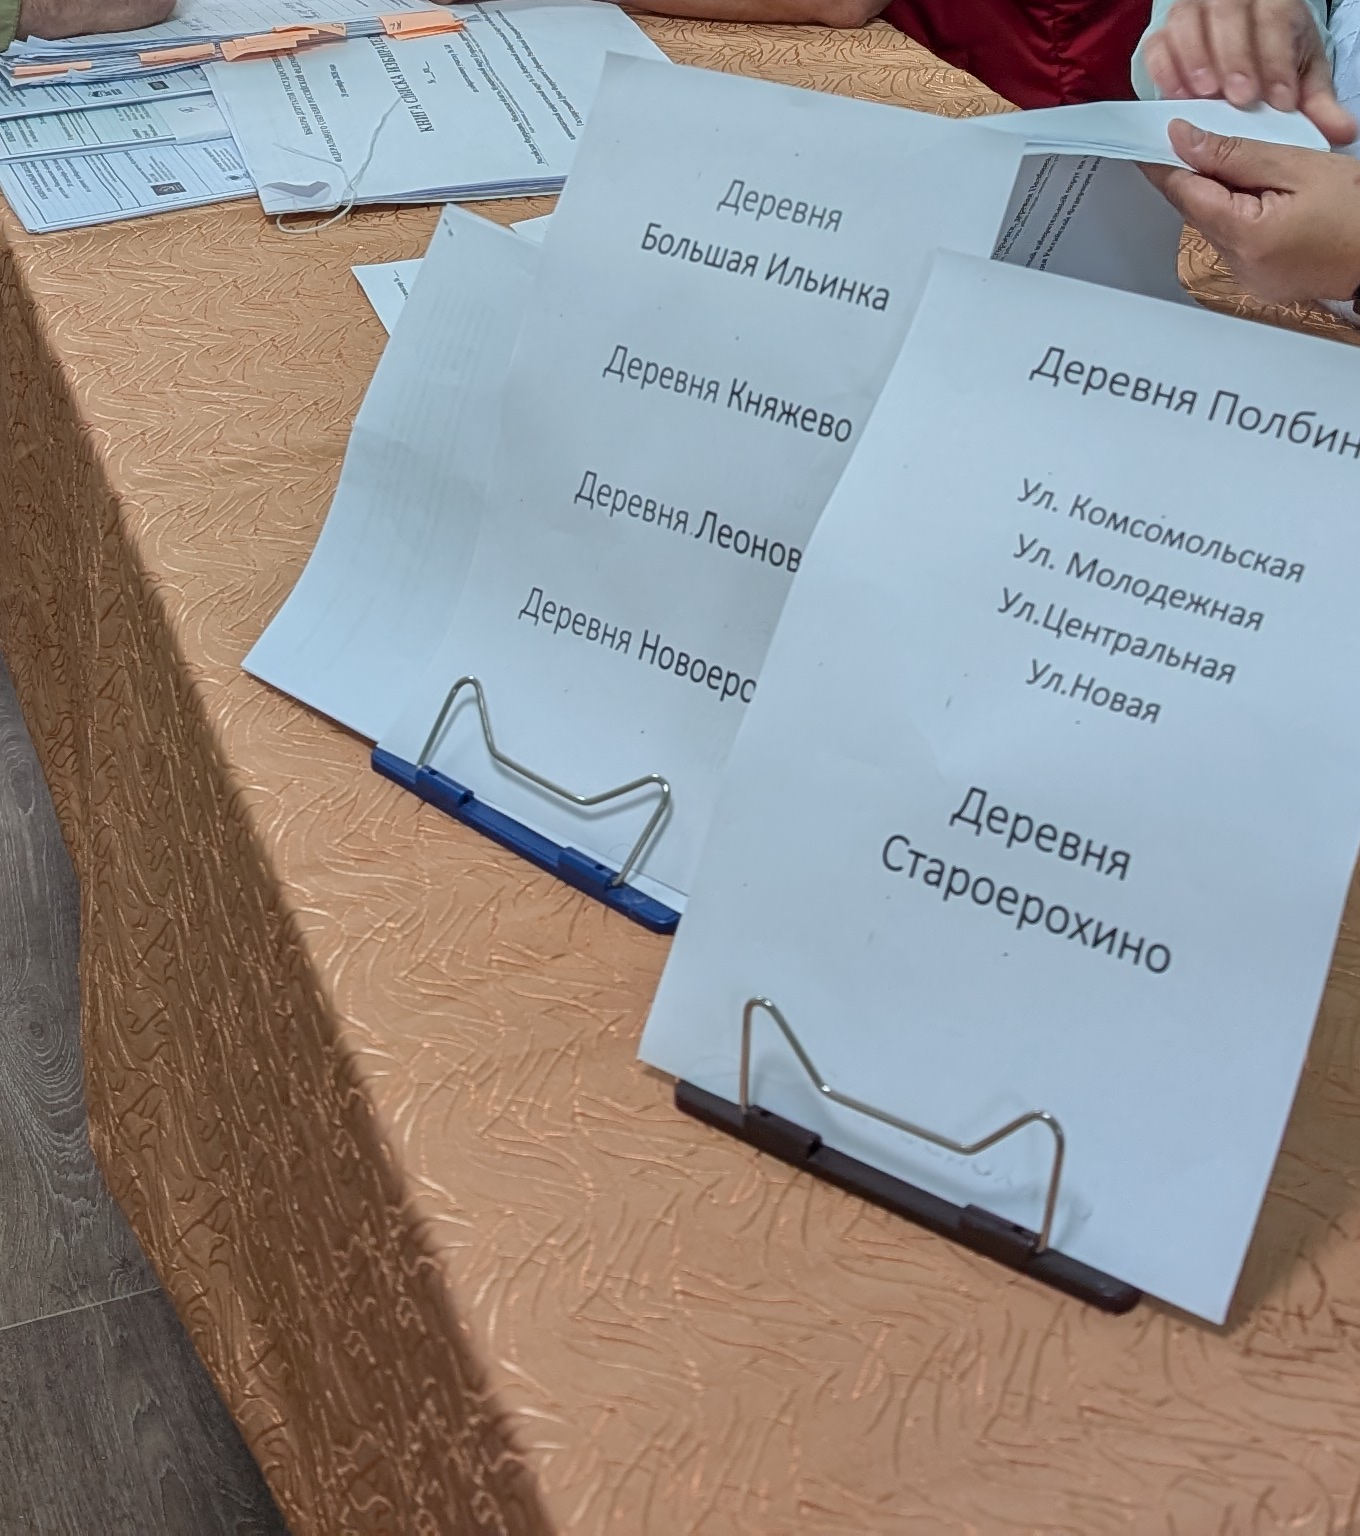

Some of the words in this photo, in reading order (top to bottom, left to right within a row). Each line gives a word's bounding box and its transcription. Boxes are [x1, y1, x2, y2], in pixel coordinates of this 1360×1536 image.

[364, 33, 403, 74] ИЗБИРАТЕЛ
[405, 103, 436, 133] КНИГА
[717, 179, 842, 232] Деревня
[641, 222, 758, 278] Большая
[764, 252, 890, 311] Ильинка
[603, 344, 720, 403] Деревня
[727, 378, 852, 443] Княжево
[1030, 345, 1198, 415] Деревня
[574, 470, 689, 535] Деревня
[694, 510, 803, 573] Леонов
[1016, 476, 1059, 513] Ул.
[1068, 493, 1306, 584] Комсомольская
[518, 586, 632, 654] Деревня
[1012, 532, 1055, 568] Ул.
[1065, 550, 1265, 632] Молодежная
[997, 586, 1237, 685] Ул.Центральная
[1025, 658, 1161, 724] Ул.Новая
[949, 785, 1132, 881] Деревня
[880, 833, 1173, 976] Староерохино
